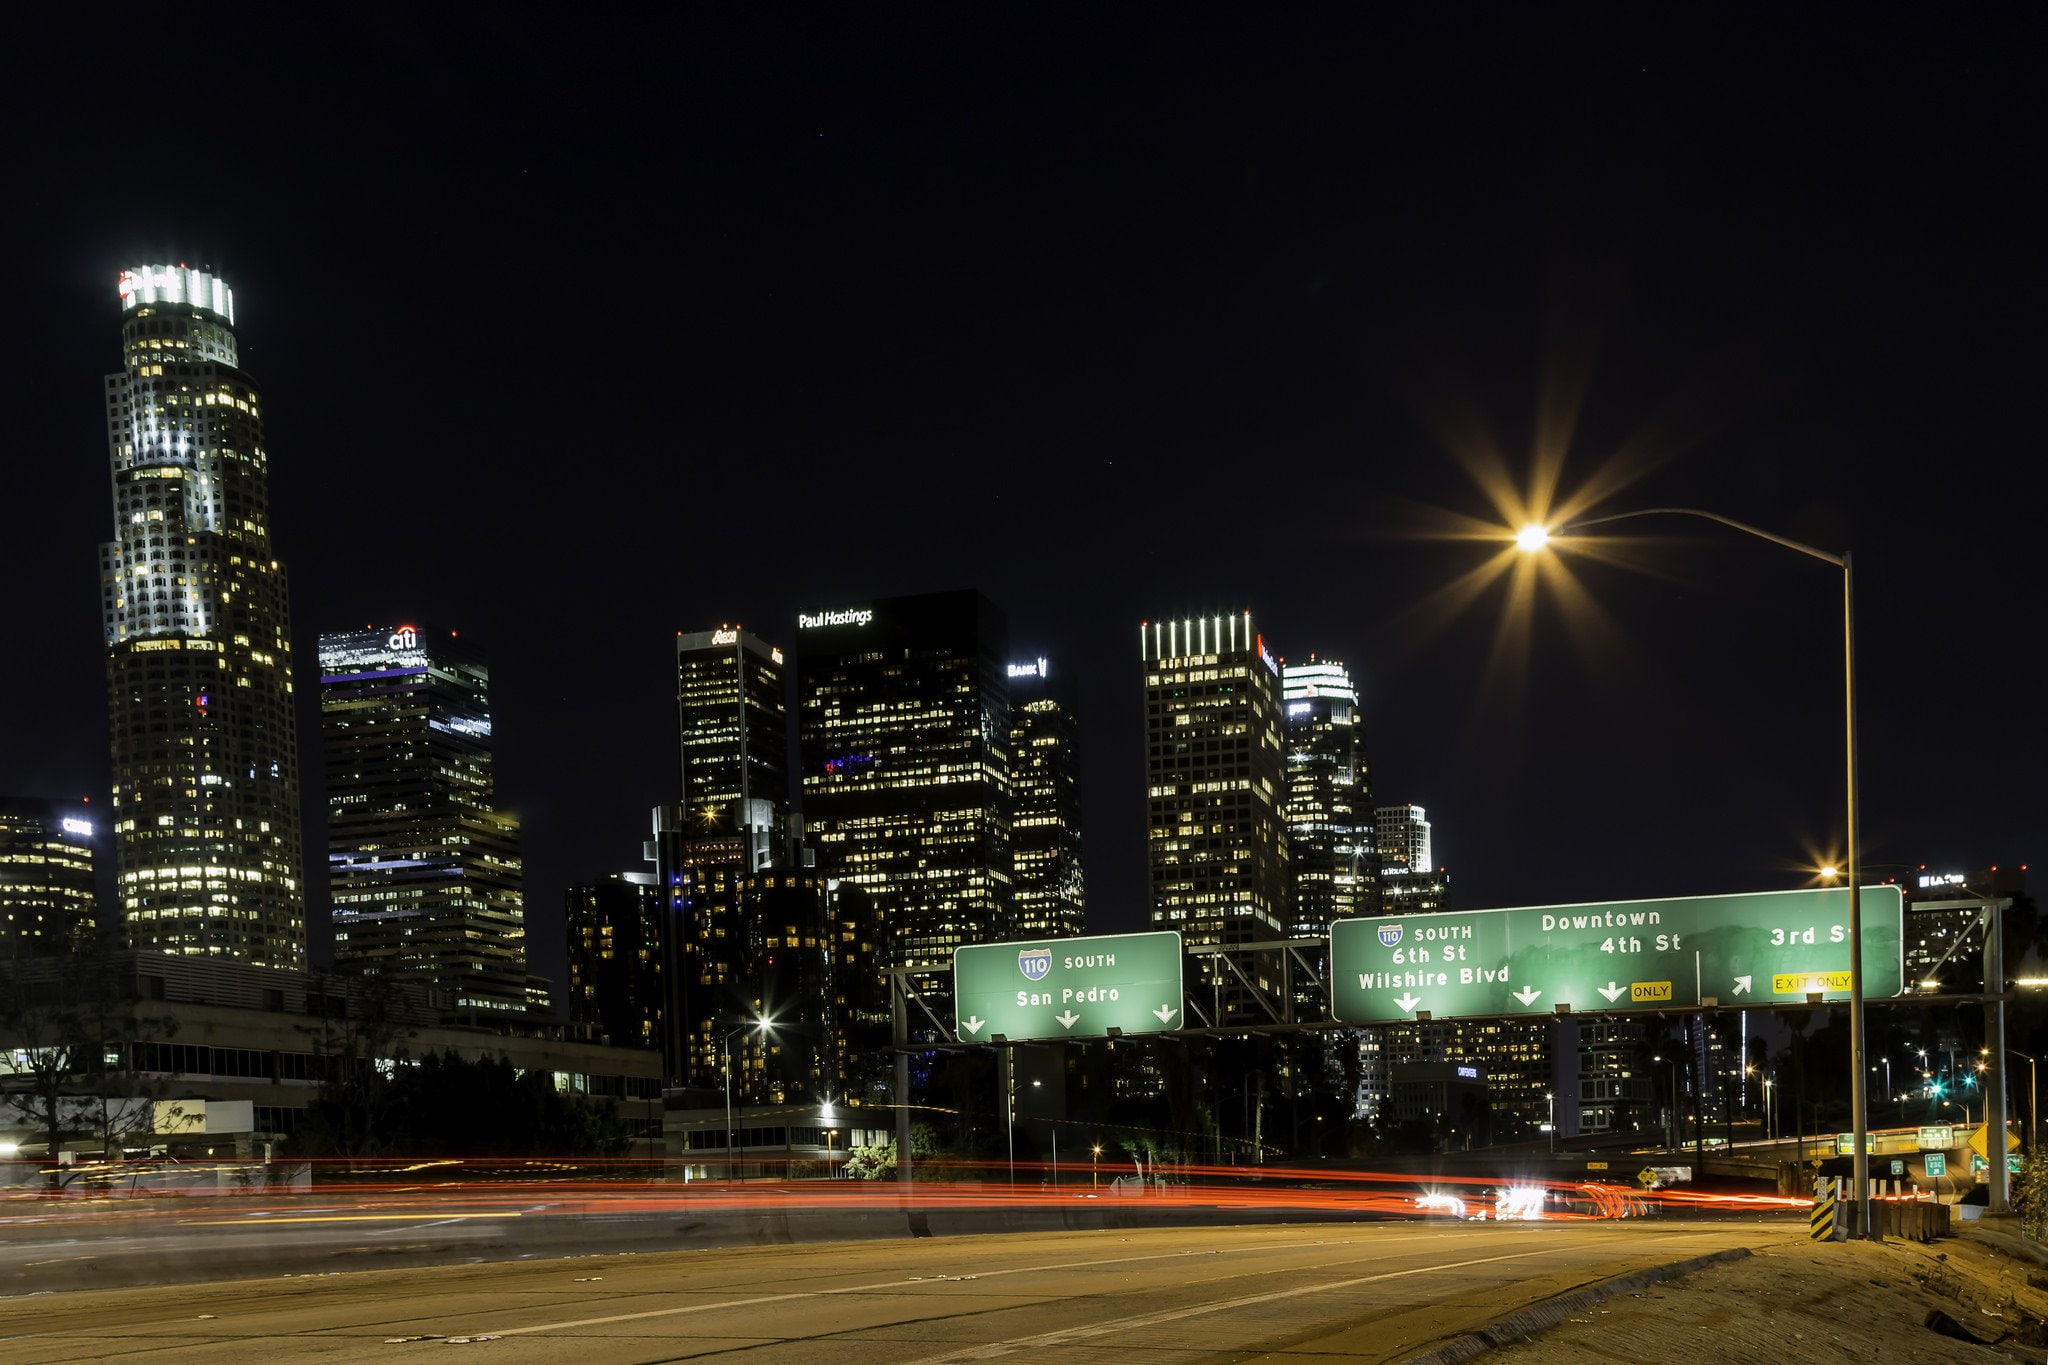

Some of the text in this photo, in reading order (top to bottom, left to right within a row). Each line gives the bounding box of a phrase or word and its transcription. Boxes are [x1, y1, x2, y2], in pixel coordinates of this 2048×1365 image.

[799, 609, 872, 628] Paul Hastings
[389, 630, 416, 650] citi
[1542, 910, 1661, 931] Downtown
[1381, 925, 1472, 943] 110 SOUTH
[1599, 933, 1681, 954] 4th St
[1770, 924, 1852, 946] 3rd S
[1023, 954, 1116, 974] 110 SOUTH
[1392, 944, 1467, 965] 6th St
[1358, 964, 1509, 990] Wilshire Blvd
[1775, 975, 1851, 989] EXIT ONLY
[1016, 986, 1119, 1007] San Pedro
[1634, 985, 1670, 998] ONLY
